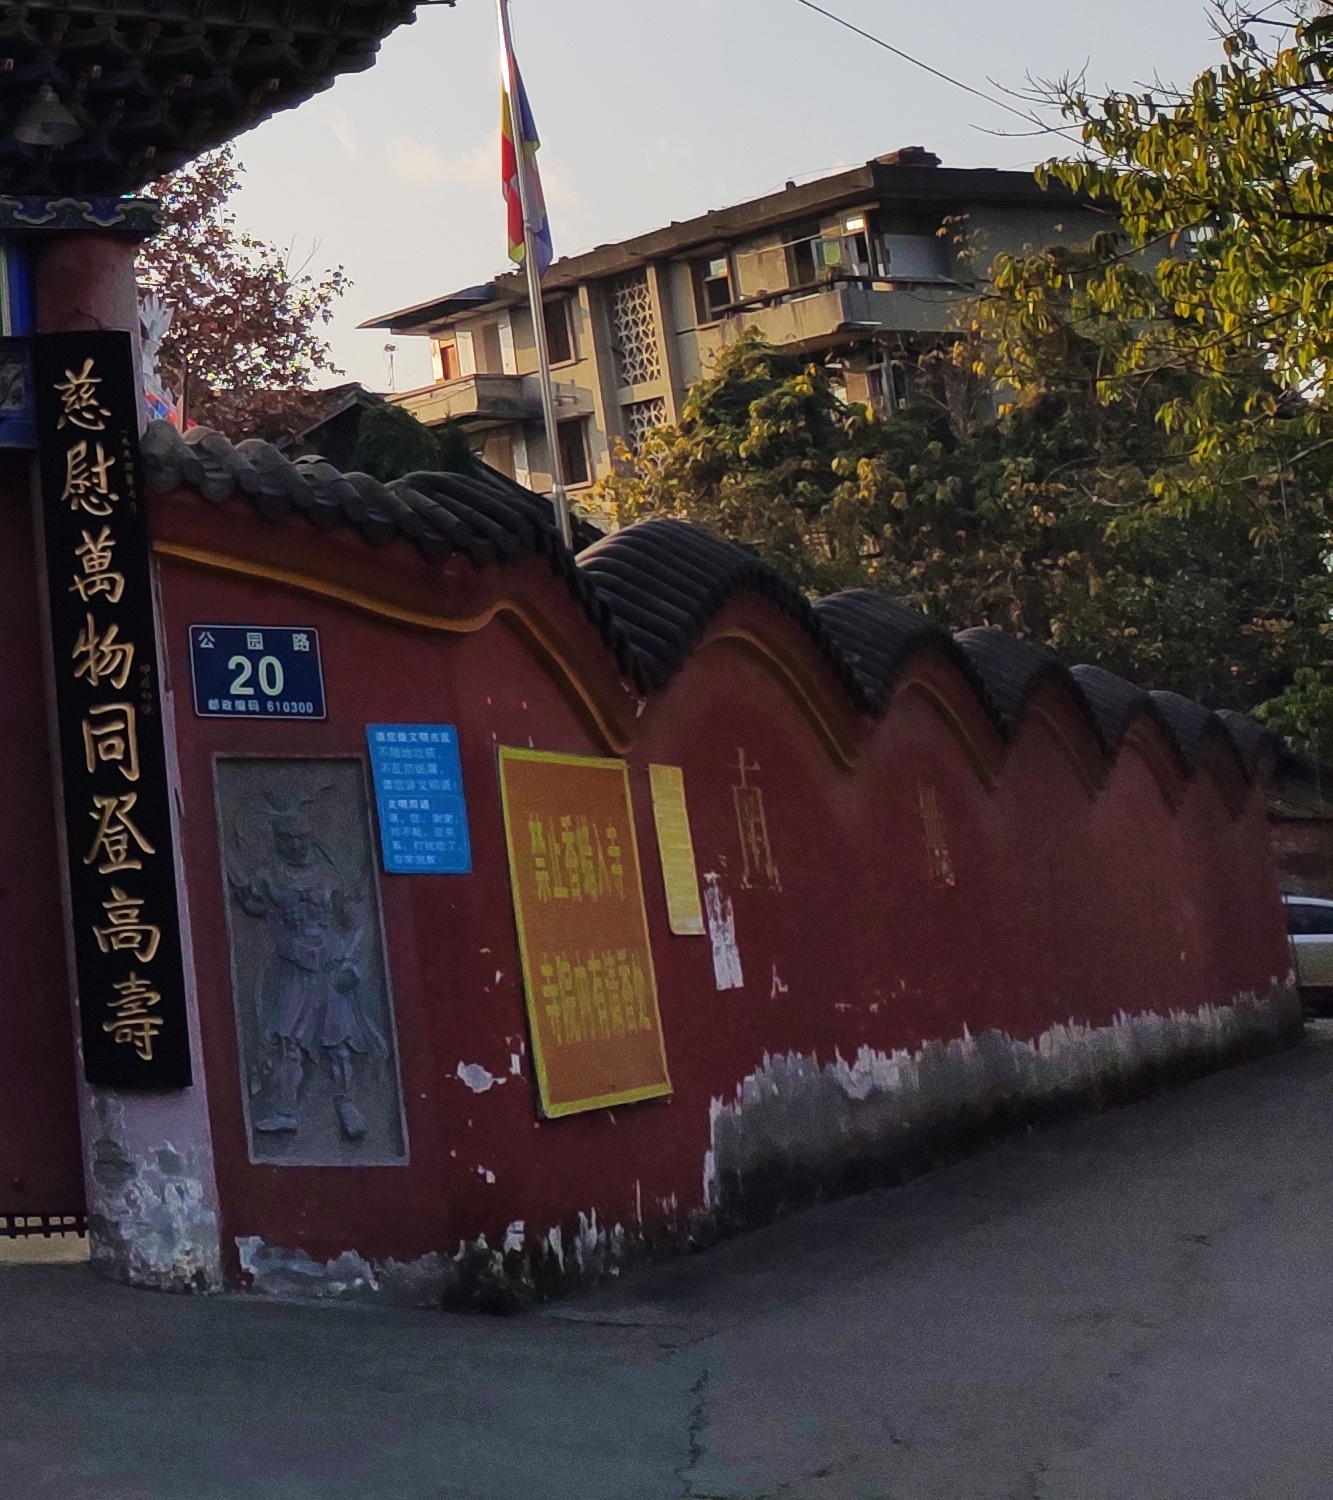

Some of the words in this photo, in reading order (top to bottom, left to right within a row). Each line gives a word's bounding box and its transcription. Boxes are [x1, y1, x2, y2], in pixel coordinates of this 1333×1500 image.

[197, 631, 311, 653] 公园路
[227, 654, 285, 697] 20
[53, 359, 166, 1061] 慈慰萬物同登高壽
[207, 697, 261, 713] 邮政编码
[266, 700, 315, 714] 610300
